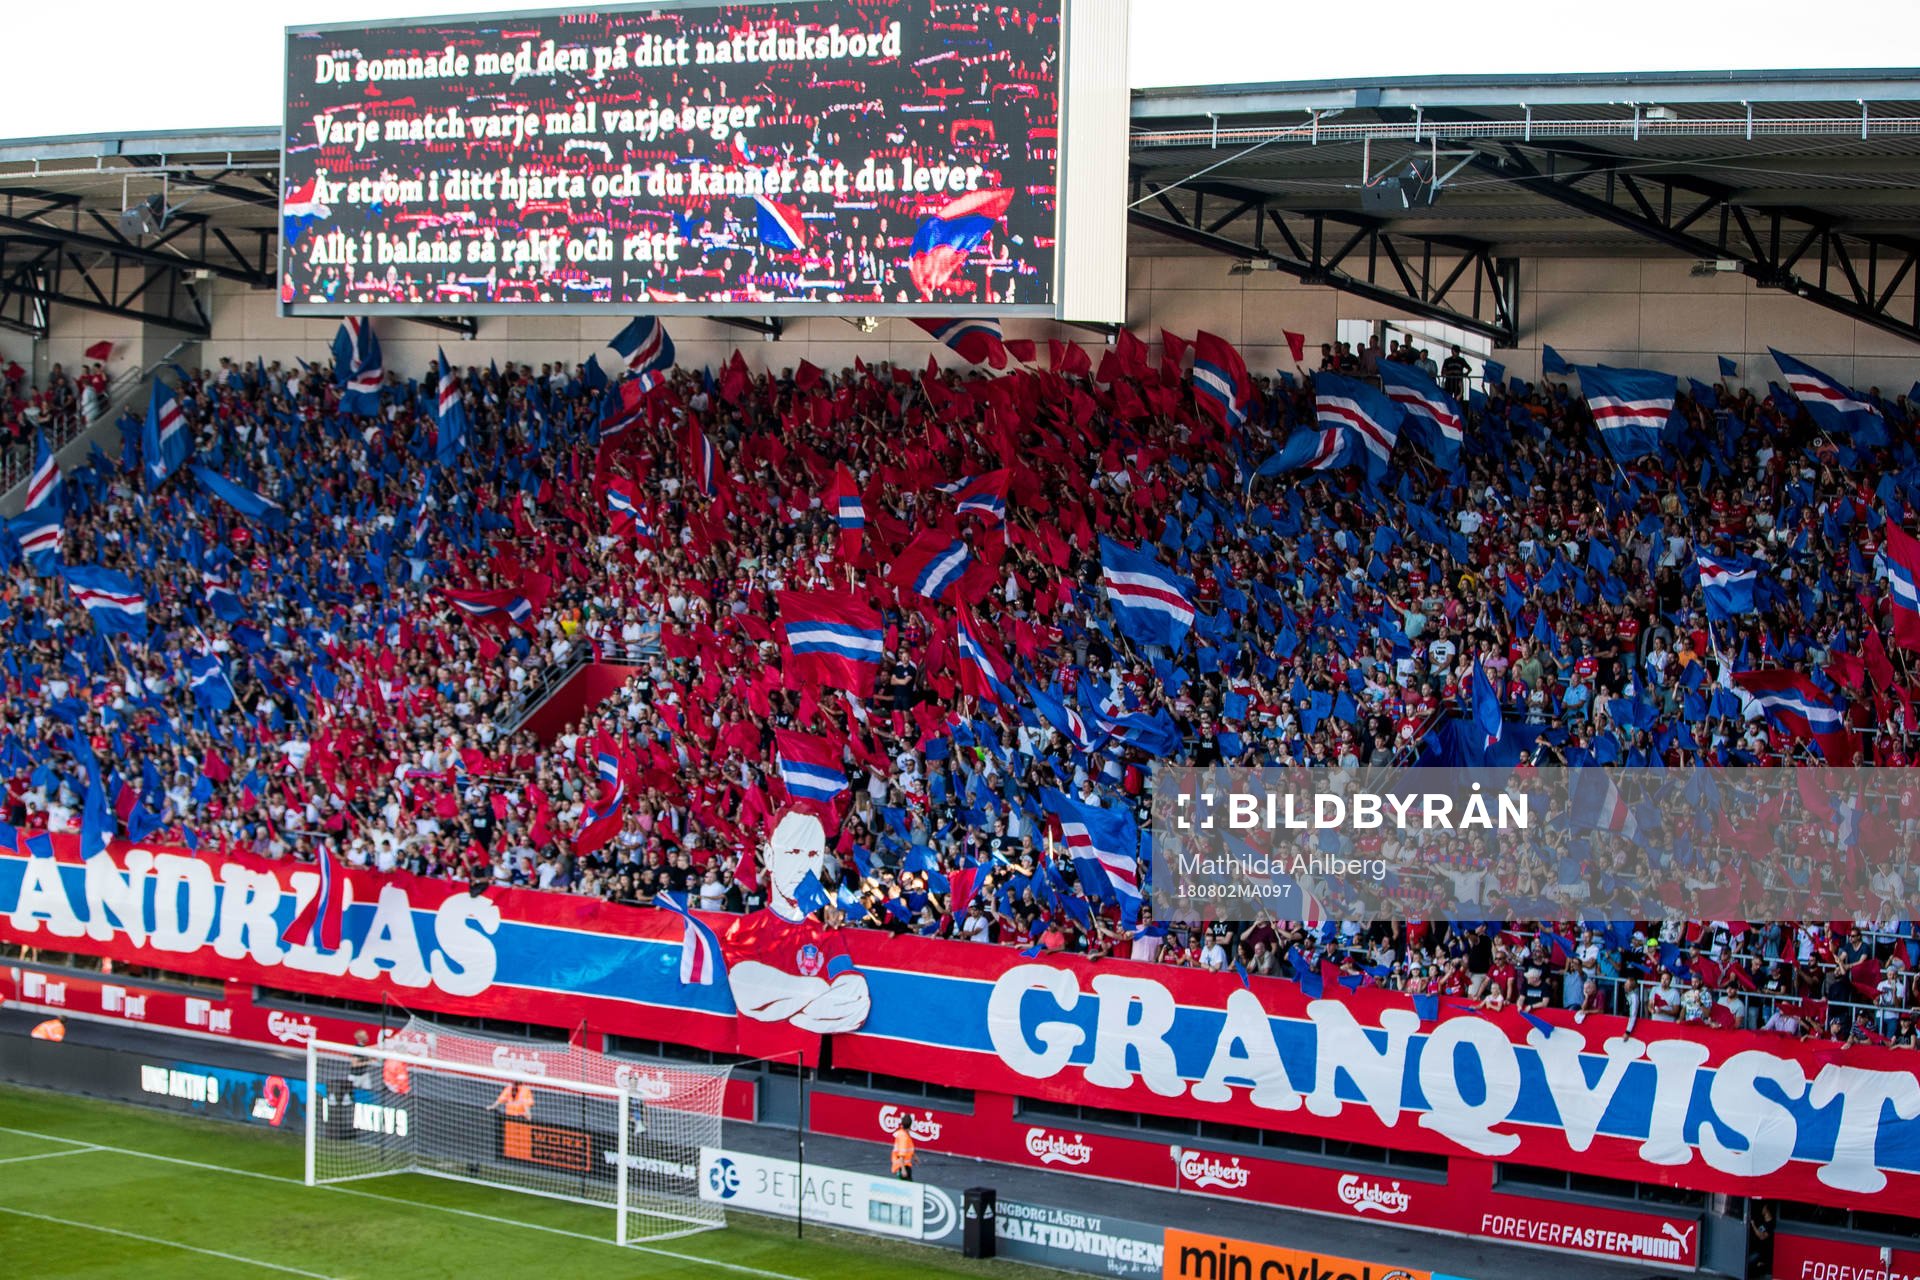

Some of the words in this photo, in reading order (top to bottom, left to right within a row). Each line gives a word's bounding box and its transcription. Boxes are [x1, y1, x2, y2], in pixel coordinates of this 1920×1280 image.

[316, 54, 350, 84] Du
[355, 46, 468, 81] somnade
[475, 41, 531, 75] med
[537, 39, 588, 72] den
[593, 35, 628, 80] på
[635, 34, 690, 67] ditt
[695, 20, 901, 65] nattduksbord
[313, 112, 379, 151] Varje
[385, 108, 465, 140] match
[470, 105, 540, 145] varje
[546, 101, 596, 135] mål
[602, 98, 675, 142] varje
[684, 103, 760, 141] seger
[312, 168, 344, 204] Är
[347, 173, 423, 203] ström
[429, 171, 438, 201] i
[444, 169, 495, 200] ditt
[500, 167, 586, 208] hjärta
[591, 163, 642, 197] och
[647, 161, 684, 196] du
[689, 162, 797, 195] känner
[802, 163, 848, 193] att
[855, 157, 895, 192] du
[902, 156, 983, 191] lever
[309, 234, 358, 265] Allt
[362, 232, 372, 263] i
[377, 230, 462, 263] balans
[467, 227, 496, 263] så
[502, 231, 562, 263] rakt
[567, 228, 613, 262] och
[623, 228, 681, 261] rätt
[988, 964, 1920, 1193] GRANQVIST
[878, 1105, 941, 1141] Carberg
[1025, 1127, 1091, 1165] Carlsberg
[1180, 1151, 1249, 1189] Carlsberg
[1337, 1174, 1410, 1214] Carlsberg
[960, 1210, 1163, 1266] KALTIDNINGEN
[1087, 1218, 1101, 1231] VI
[1180, 1242, 1251, 1280] min
